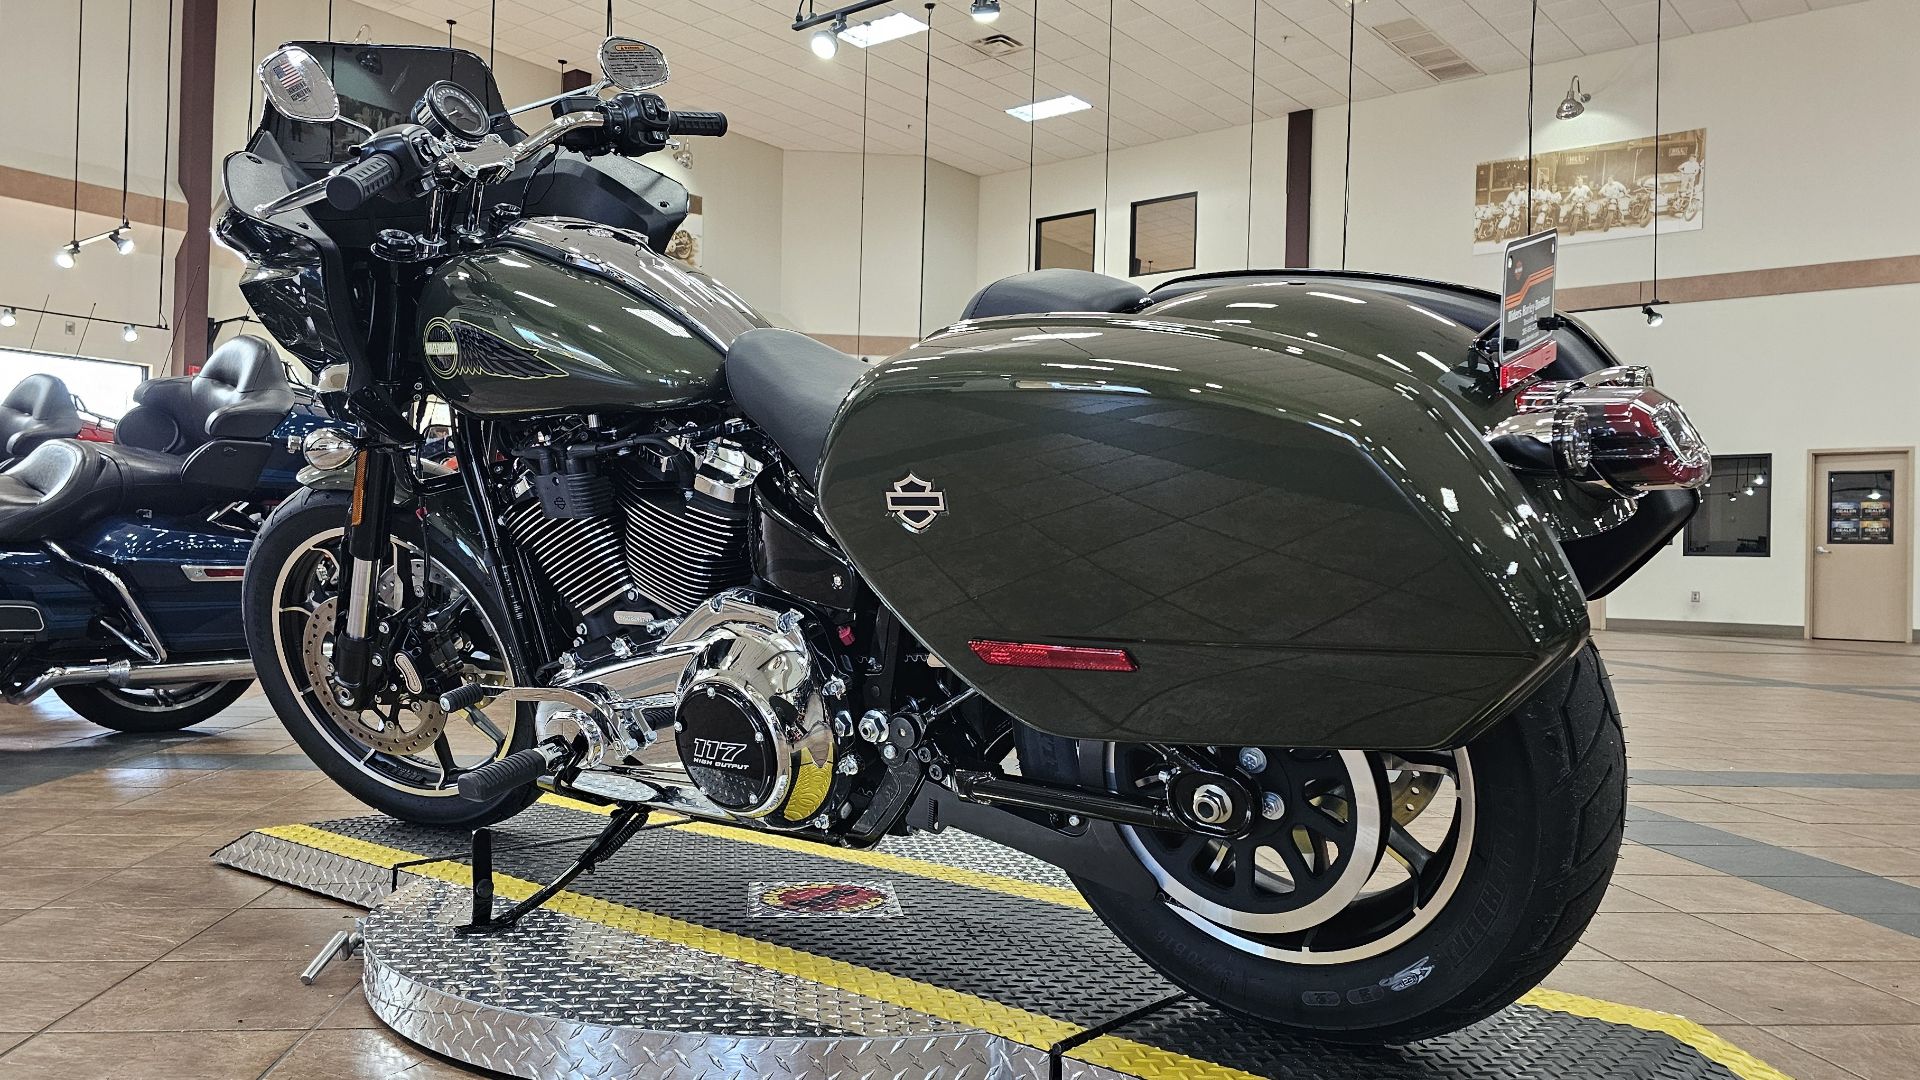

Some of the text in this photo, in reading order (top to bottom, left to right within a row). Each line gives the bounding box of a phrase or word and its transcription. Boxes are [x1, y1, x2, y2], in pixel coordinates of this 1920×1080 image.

[694, 738, 748, 762] 117
[693, 757, 750, 770] HIGH OUTPUT
